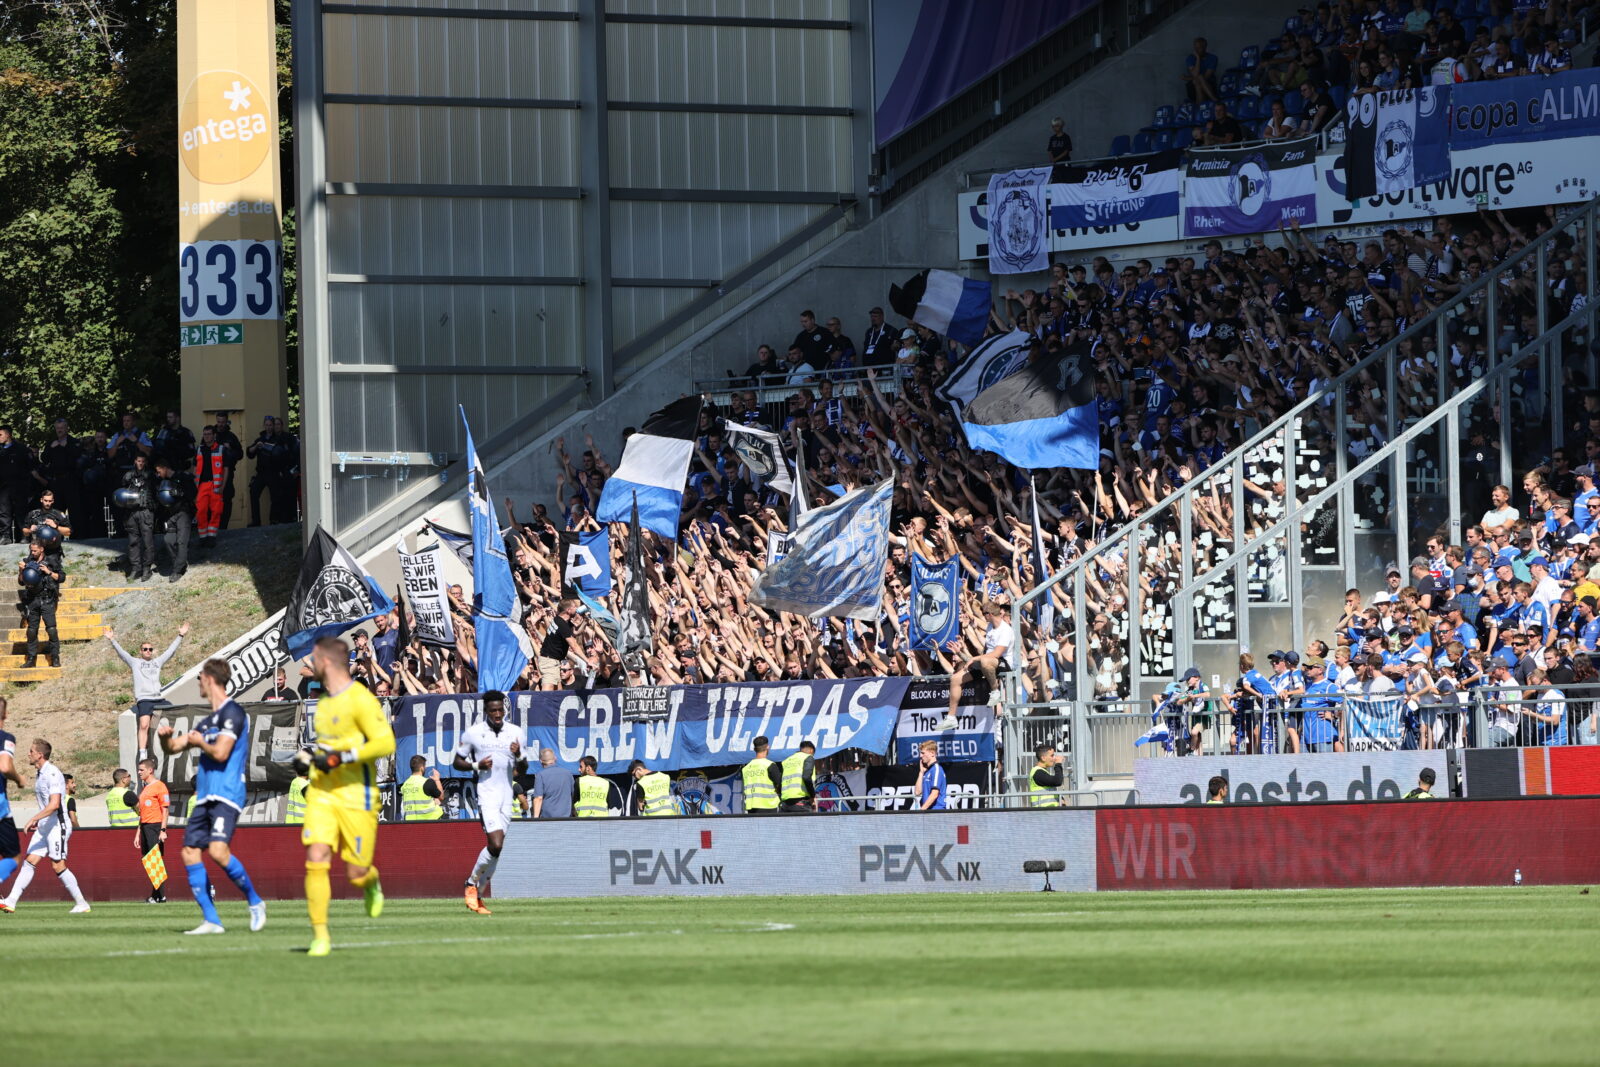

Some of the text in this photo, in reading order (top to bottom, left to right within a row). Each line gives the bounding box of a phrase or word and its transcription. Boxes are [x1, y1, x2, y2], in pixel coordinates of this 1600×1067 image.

[1379, 88, 1415, 109] PLUS
[1455, 98, 1519, 138] copa
[183, 113, 267, 151] entega
[1192, 149, 1306, 171] Arminia Fans
[1517, 160, 1533, 175] AG
[192, 199, 273, 216] entega.de
[1281, 205, 1306, 220] Main
[403, 554, 434, 566] ALLES
[414, 564, 436, 577] WIR
[422, 612, 443, 624] WIR
[911, 690, 931, 700] BLOCK
[932, 690, 937, 699] 6
[558, 689, 684, 764] CREW
[705, 680, 886, 754] ULTRAS
[911, 711, 977, 733] The Frm
[911, 740, 978, 759] BEFELD
[213, 816, 225, 833] 4
[55, 841, 60, 851] 5
[355, 836, 361, 854] 1
[1107, 822, 1197, 880] WIR
[610, 848, 725, 886] PEAK NX
[860, 843, 981, 883] PEAK NX
